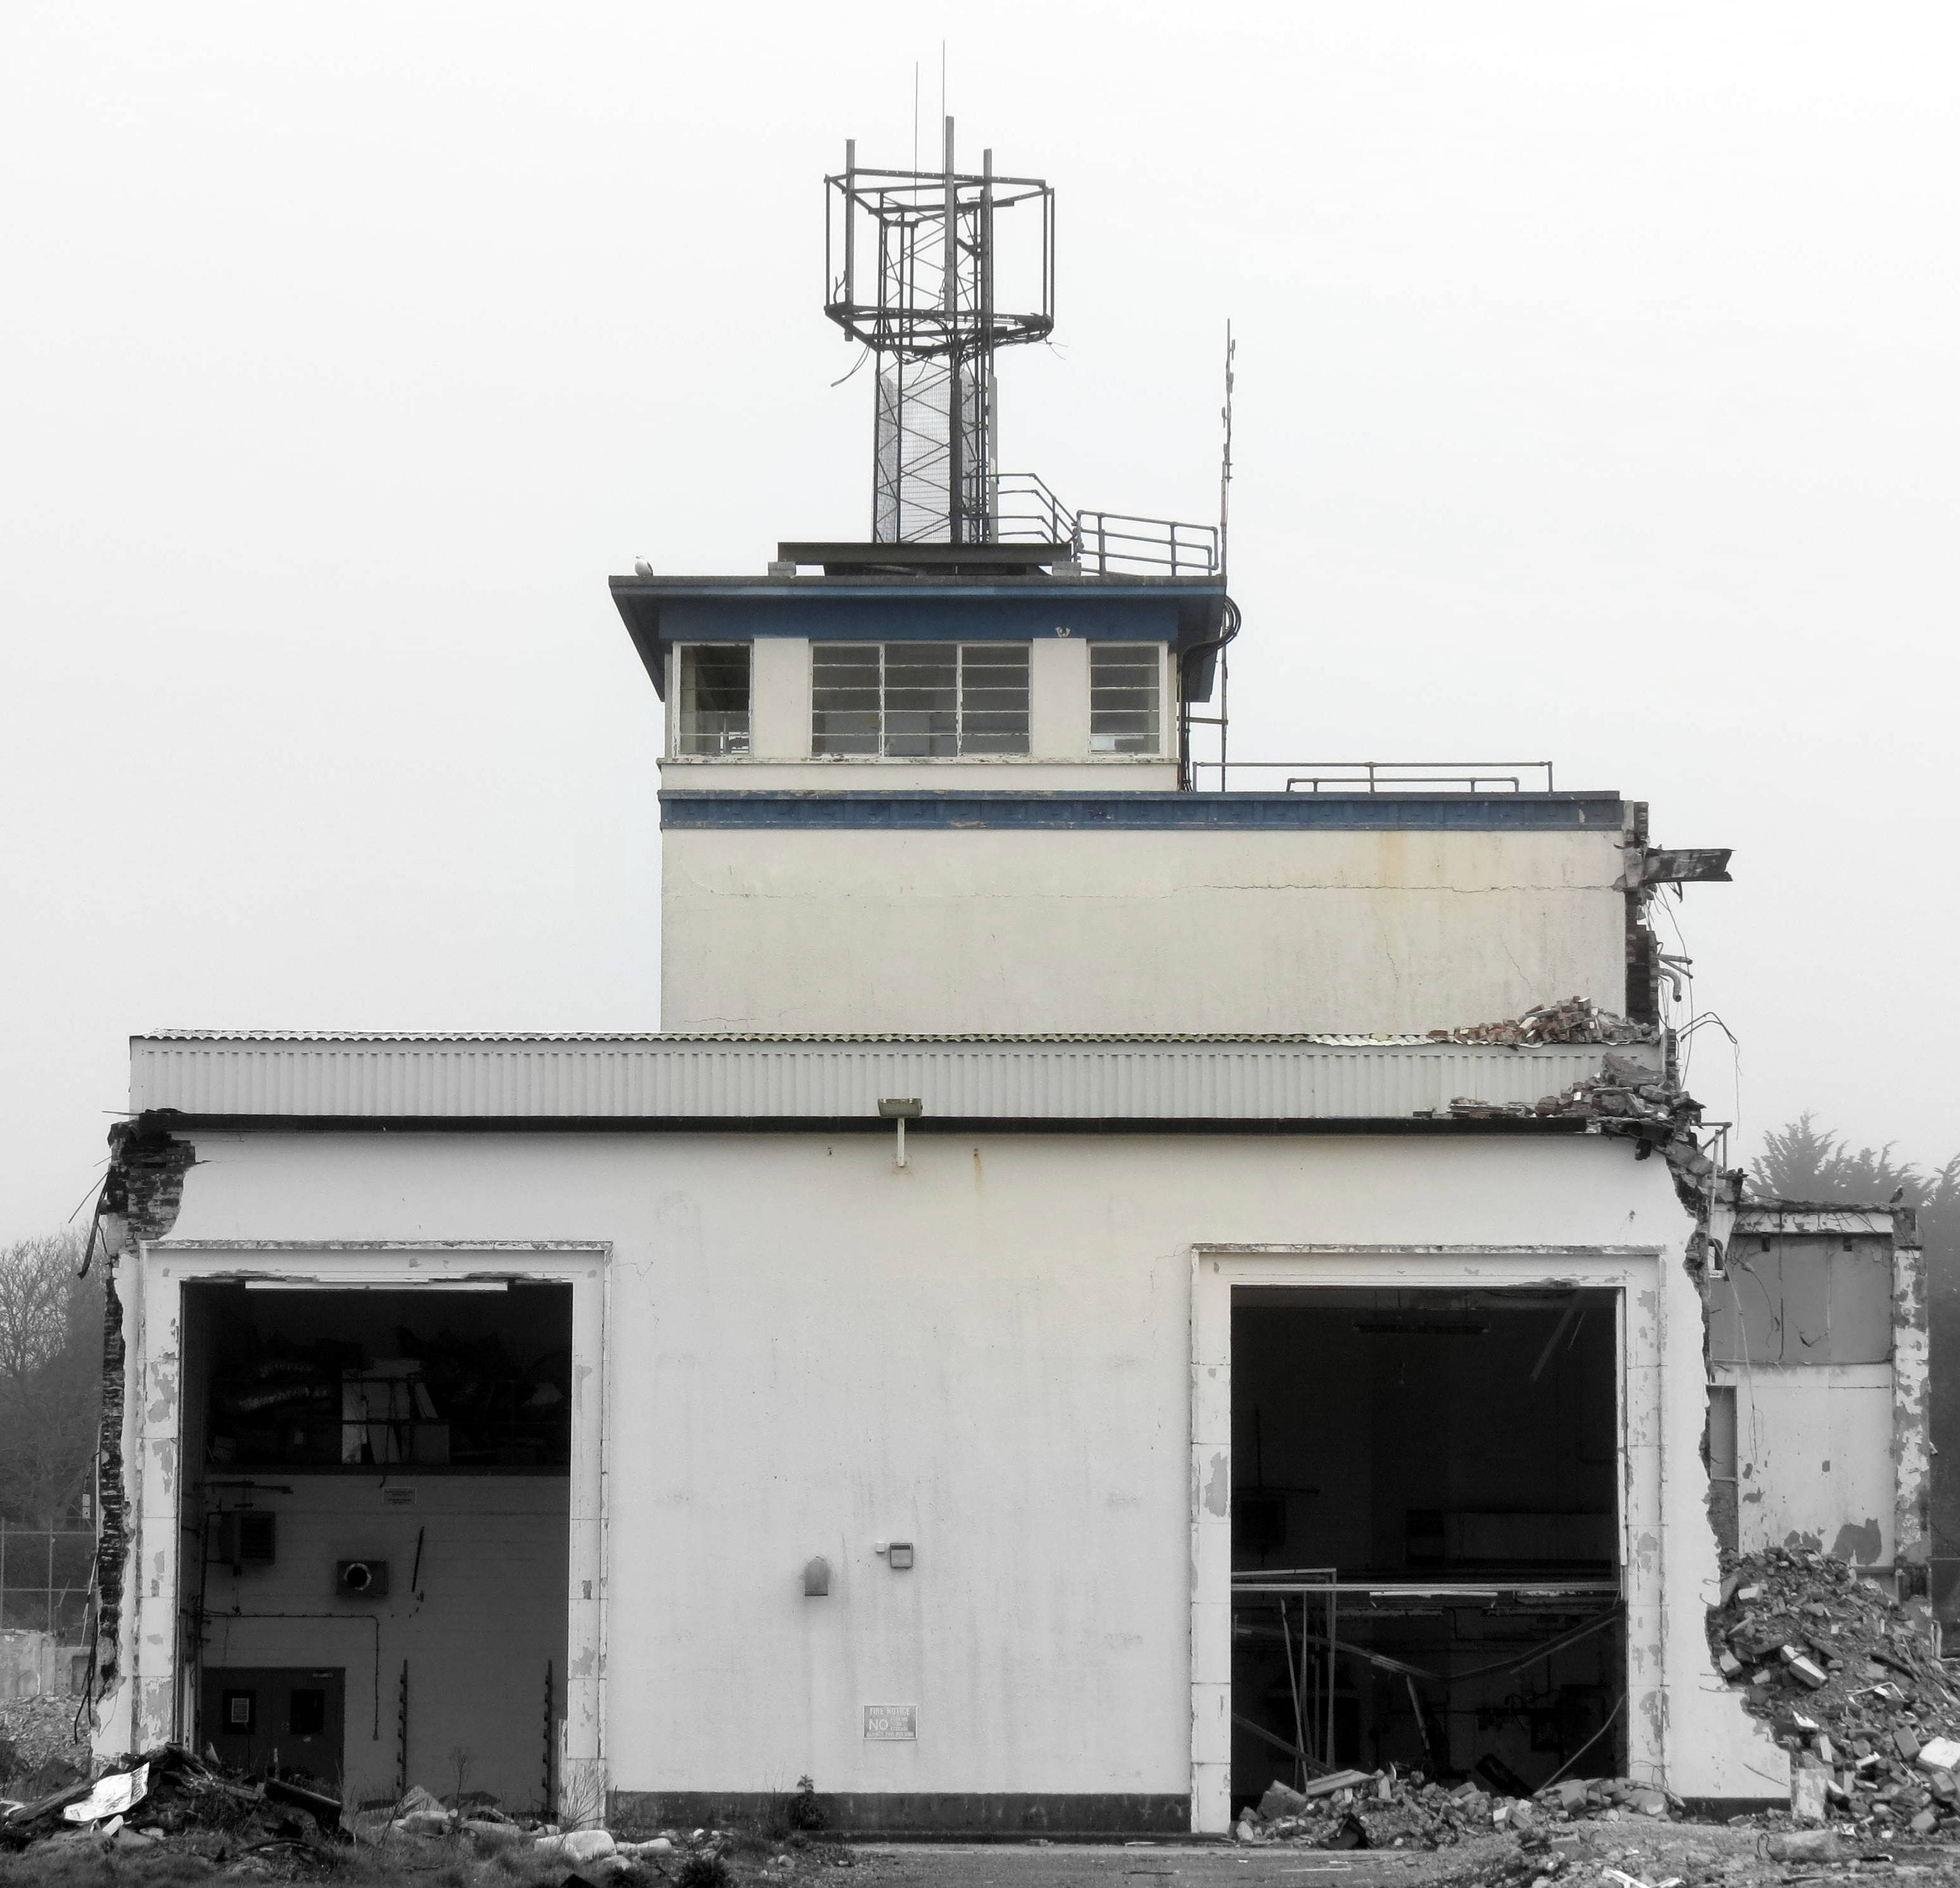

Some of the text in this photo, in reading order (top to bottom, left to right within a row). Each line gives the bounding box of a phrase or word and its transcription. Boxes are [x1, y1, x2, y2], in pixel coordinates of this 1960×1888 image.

[869, 1707, 910, 1715] FIRE NOTICE
[869, 1718, 889, 1730] NO
